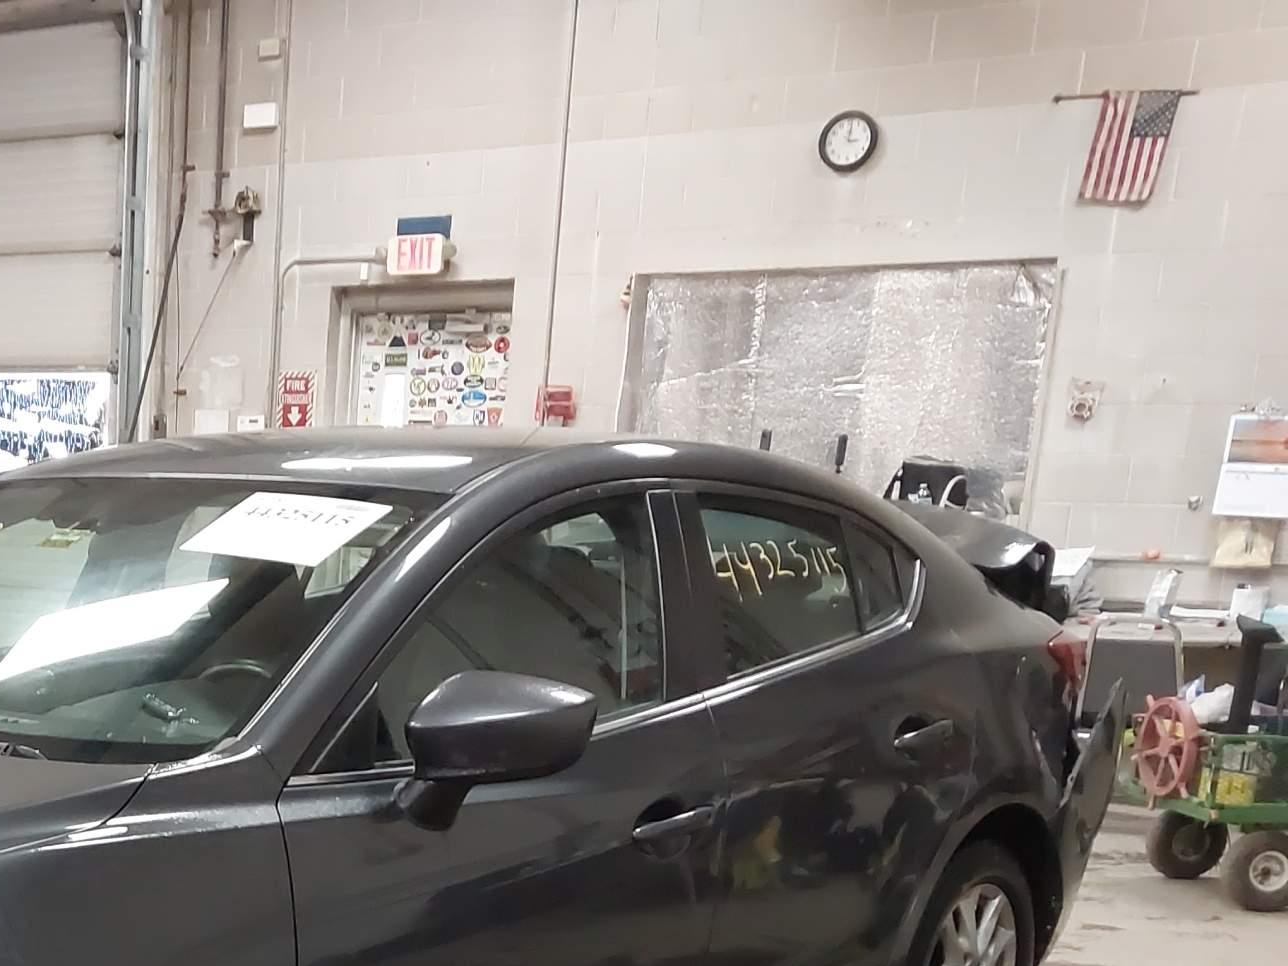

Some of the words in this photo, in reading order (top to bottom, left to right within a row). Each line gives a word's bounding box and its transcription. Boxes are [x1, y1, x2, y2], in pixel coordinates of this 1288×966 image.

[396, 236, 436, 271] EXIT
[286, 380, 307, 391] FIRE
[706, 534, 848, 603] 44325115
